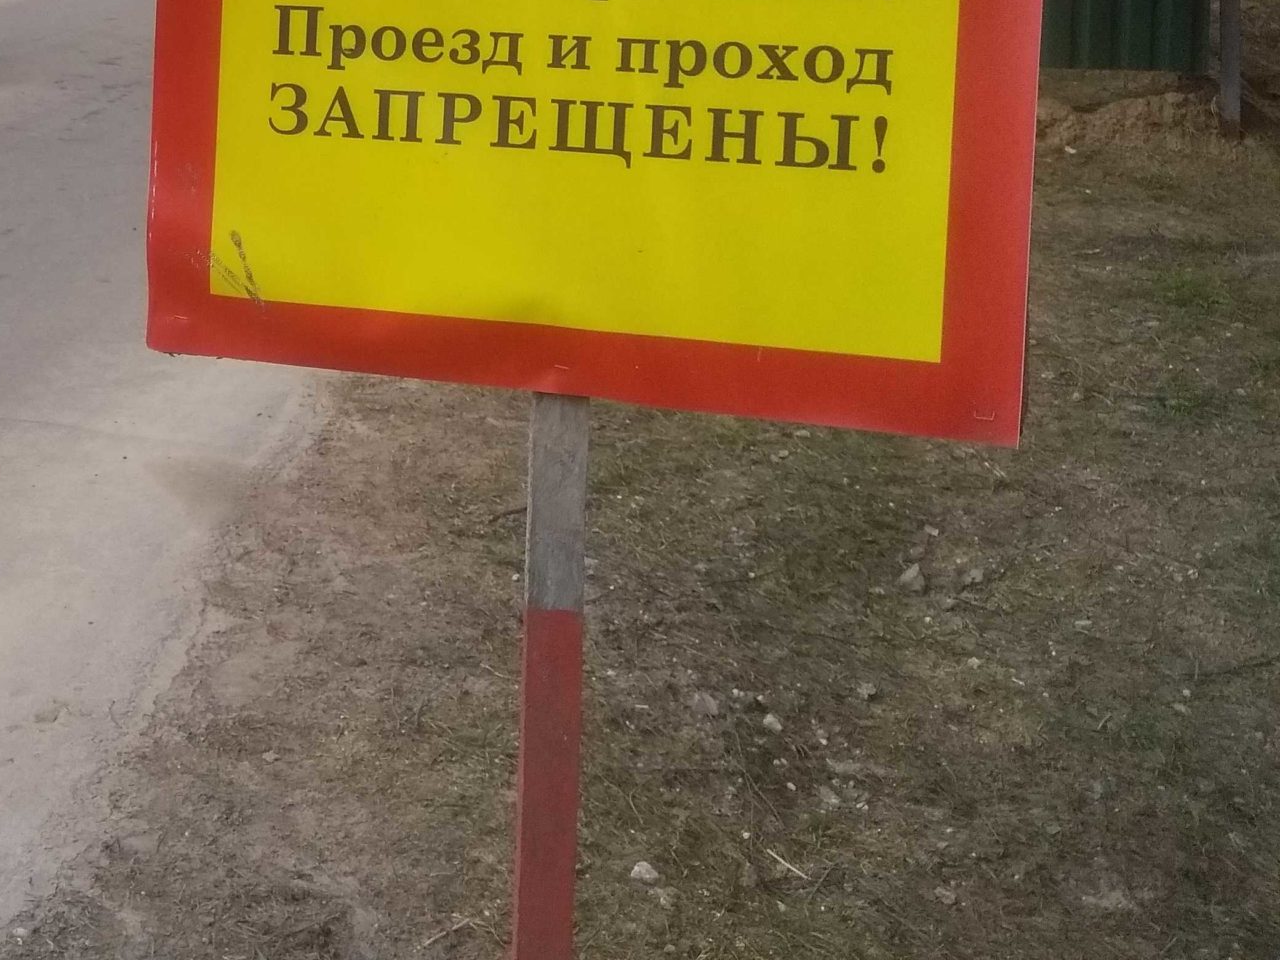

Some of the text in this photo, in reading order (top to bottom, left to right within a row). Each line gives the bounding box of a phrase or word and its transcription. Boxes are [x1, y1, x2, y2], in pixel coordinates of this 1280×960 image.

[272, 4, 894, 96] Проезд и проход
[268, 82, 888, 174] ЗАПРЕЩЕНЫ!
